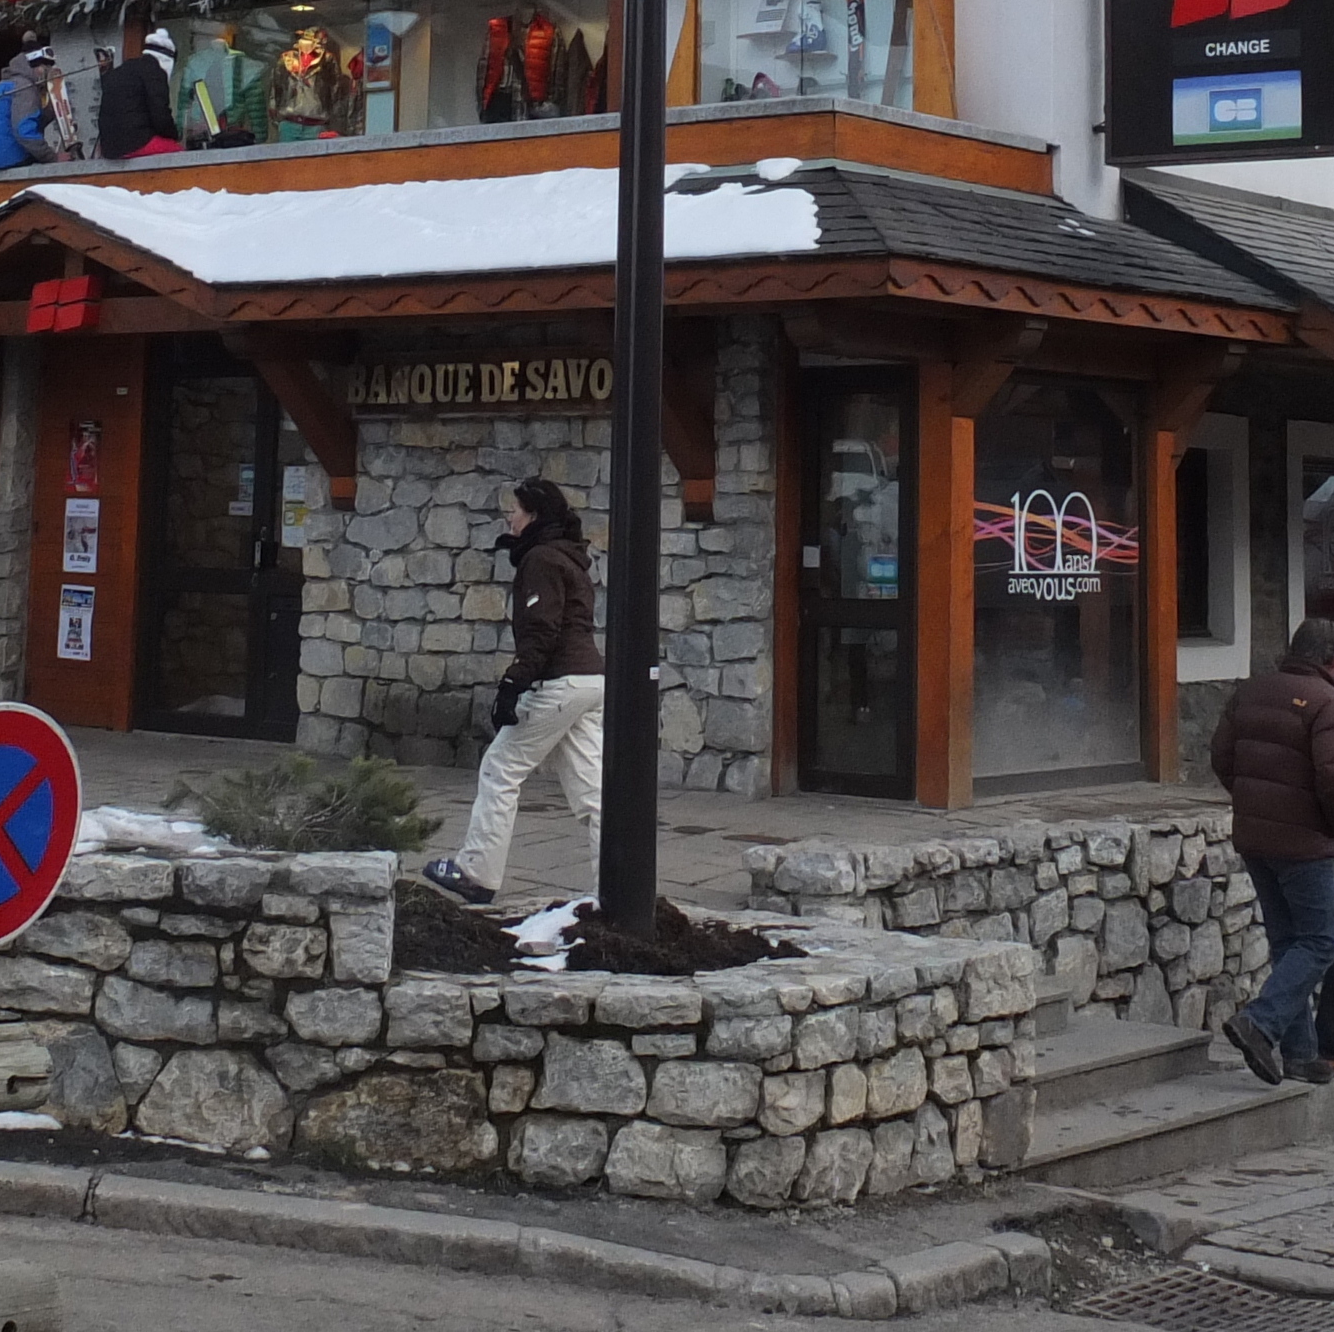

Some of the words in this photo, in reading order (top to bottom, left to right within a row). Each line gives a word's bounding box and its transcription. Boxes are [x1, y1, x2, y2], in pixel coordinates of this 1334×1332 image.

[1205, 39, 1271, 57] CHANGE
[347, 363, 474, 404] BANQUE
[480, 361, 519, 403] DE
[525, 358, 614, 401] SAVO
[1010, 489, 1098, 573] 100
[1064, 554, 1090, 572] ans
